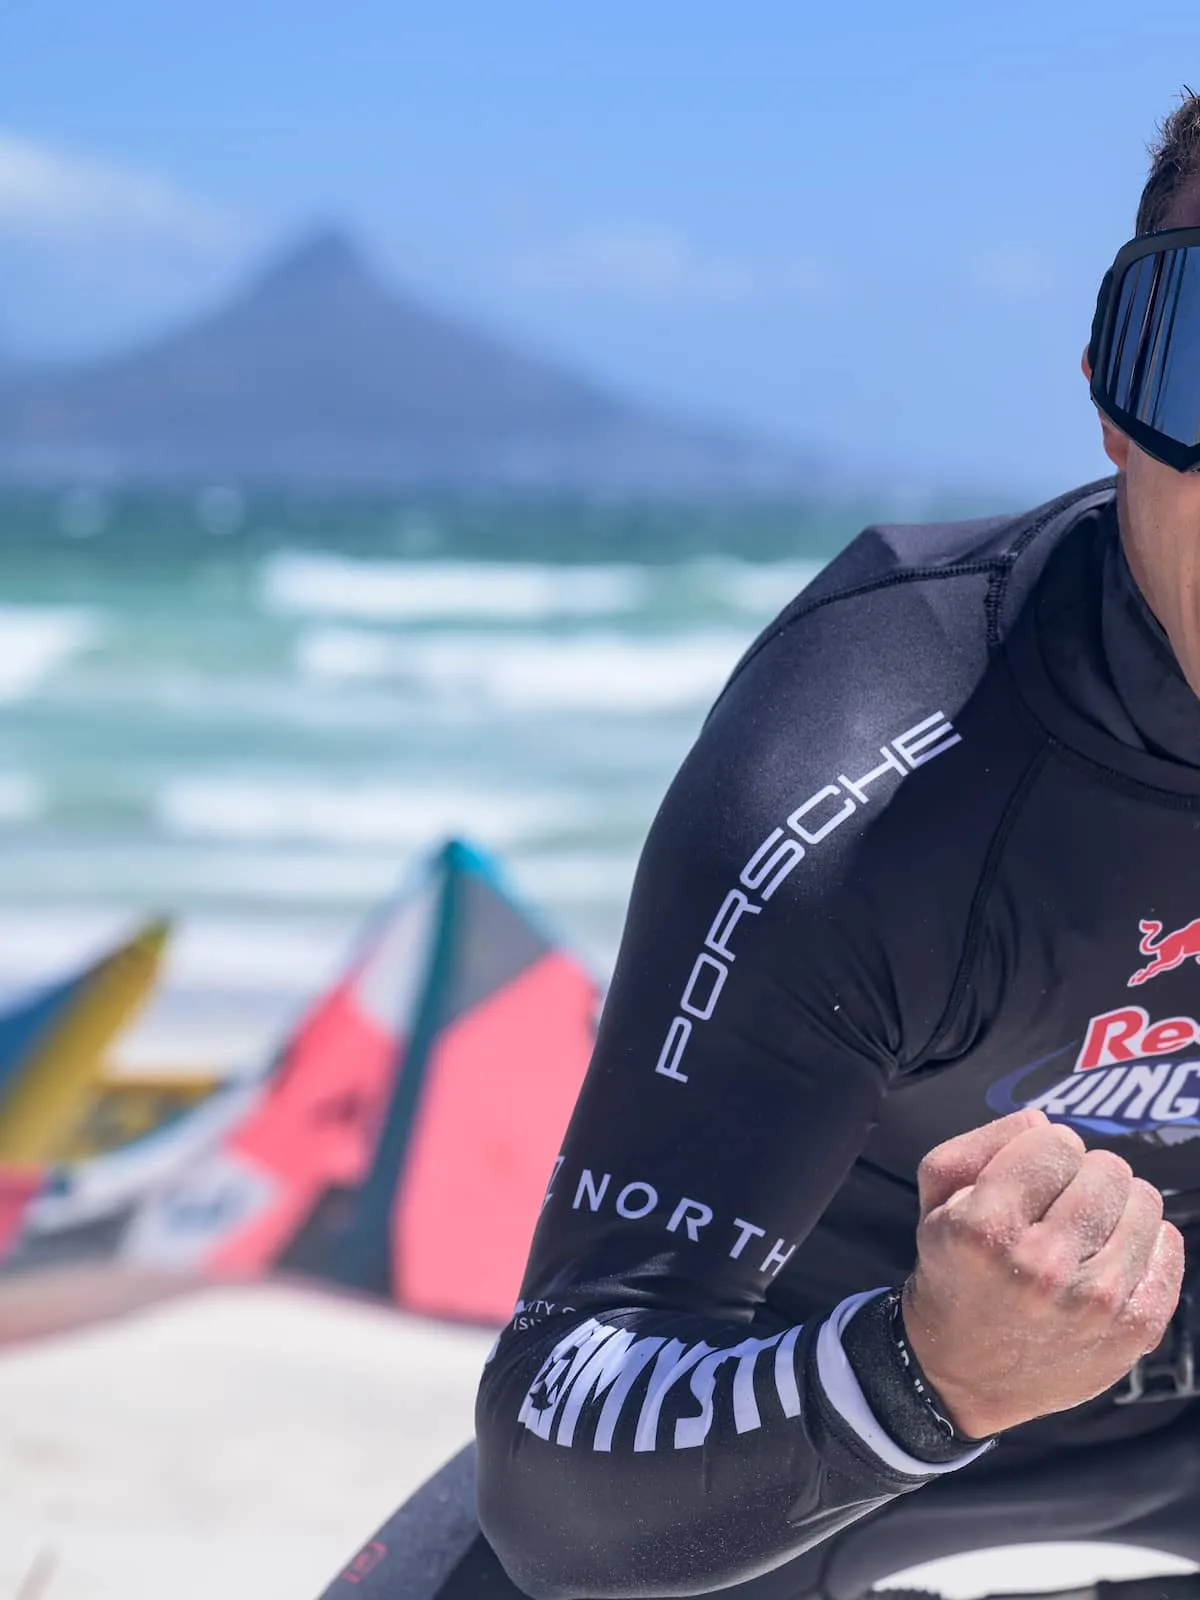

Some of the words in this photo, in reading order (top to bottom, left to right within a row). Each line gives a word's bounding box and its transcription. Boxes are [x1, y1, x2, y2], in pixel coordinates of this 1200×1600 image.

[655, 710, 963, 1084] PORSCHE
[571, 1168, 797, 1277] NORTH
[556, 1324, 804, 1453] MYSTI
